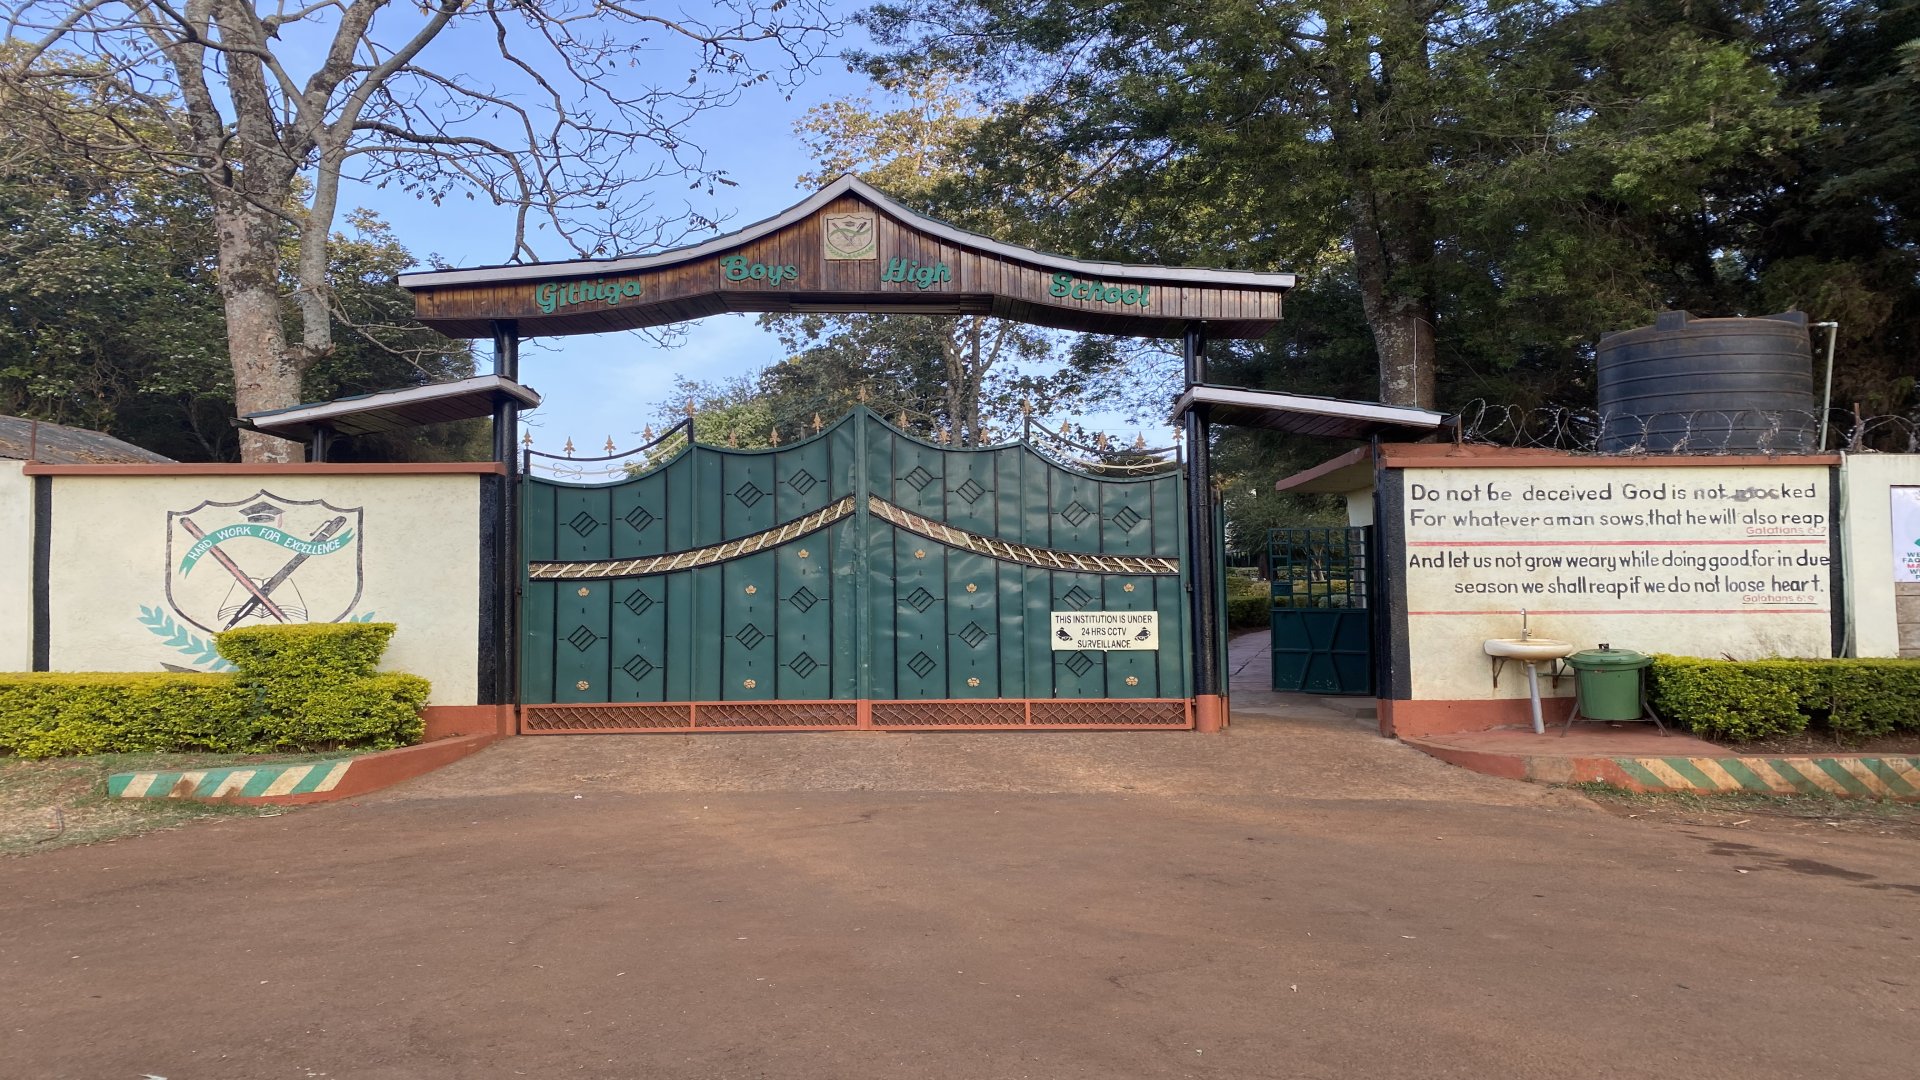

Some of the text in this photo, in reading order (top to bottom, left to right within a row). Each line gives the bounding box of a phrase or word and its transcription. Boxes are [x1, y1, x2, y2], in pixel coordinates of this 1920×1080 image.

[536, 255, 1151, 314] Githiga Boys High School
[1411, 482, 1816, 502] Do not be deceived God is not ocked
[1410, 509, 1446, 527] For
[1453, 510, 1540, 528] whatever
[1543, 517, 1555, 526] a
[1556, 515, 1595, 526] man
[1649, 509, 1682, 526] that
[1686, 509, 1707, 525] he
[1709, 508, 1736, 525] will
[1742, 508, 1777, 525] also
[1781, 514, 1824, 528] reap
[188, 526, 341, 560] HARD WORK FOR EXCELLENCE
[1409, 551, 1445, 568] And
[1448, 551, 1470, 568] let
[1473, 556, 1492, 568] us
[1495, 551, 1522, 568] not
[1525, 556, 1562, 572] grow
[1567, 556, 1617, 572] weary
[1619, 551, 1660, 568] while
[1662, 550, 1706, 572] doing
[1752, 549, 1775, 567] for
[1778, 550, 1793, 567] in
[1796, 549, 1830, 567] due
[1454, 574, 1824, 600] season we shall reap if we do not loose heart.
[1055, 615, 1153, 624] THIS INSTITUTION IS UNDER
[1081, 627, 1127, 636] 24 HRS CCTV
